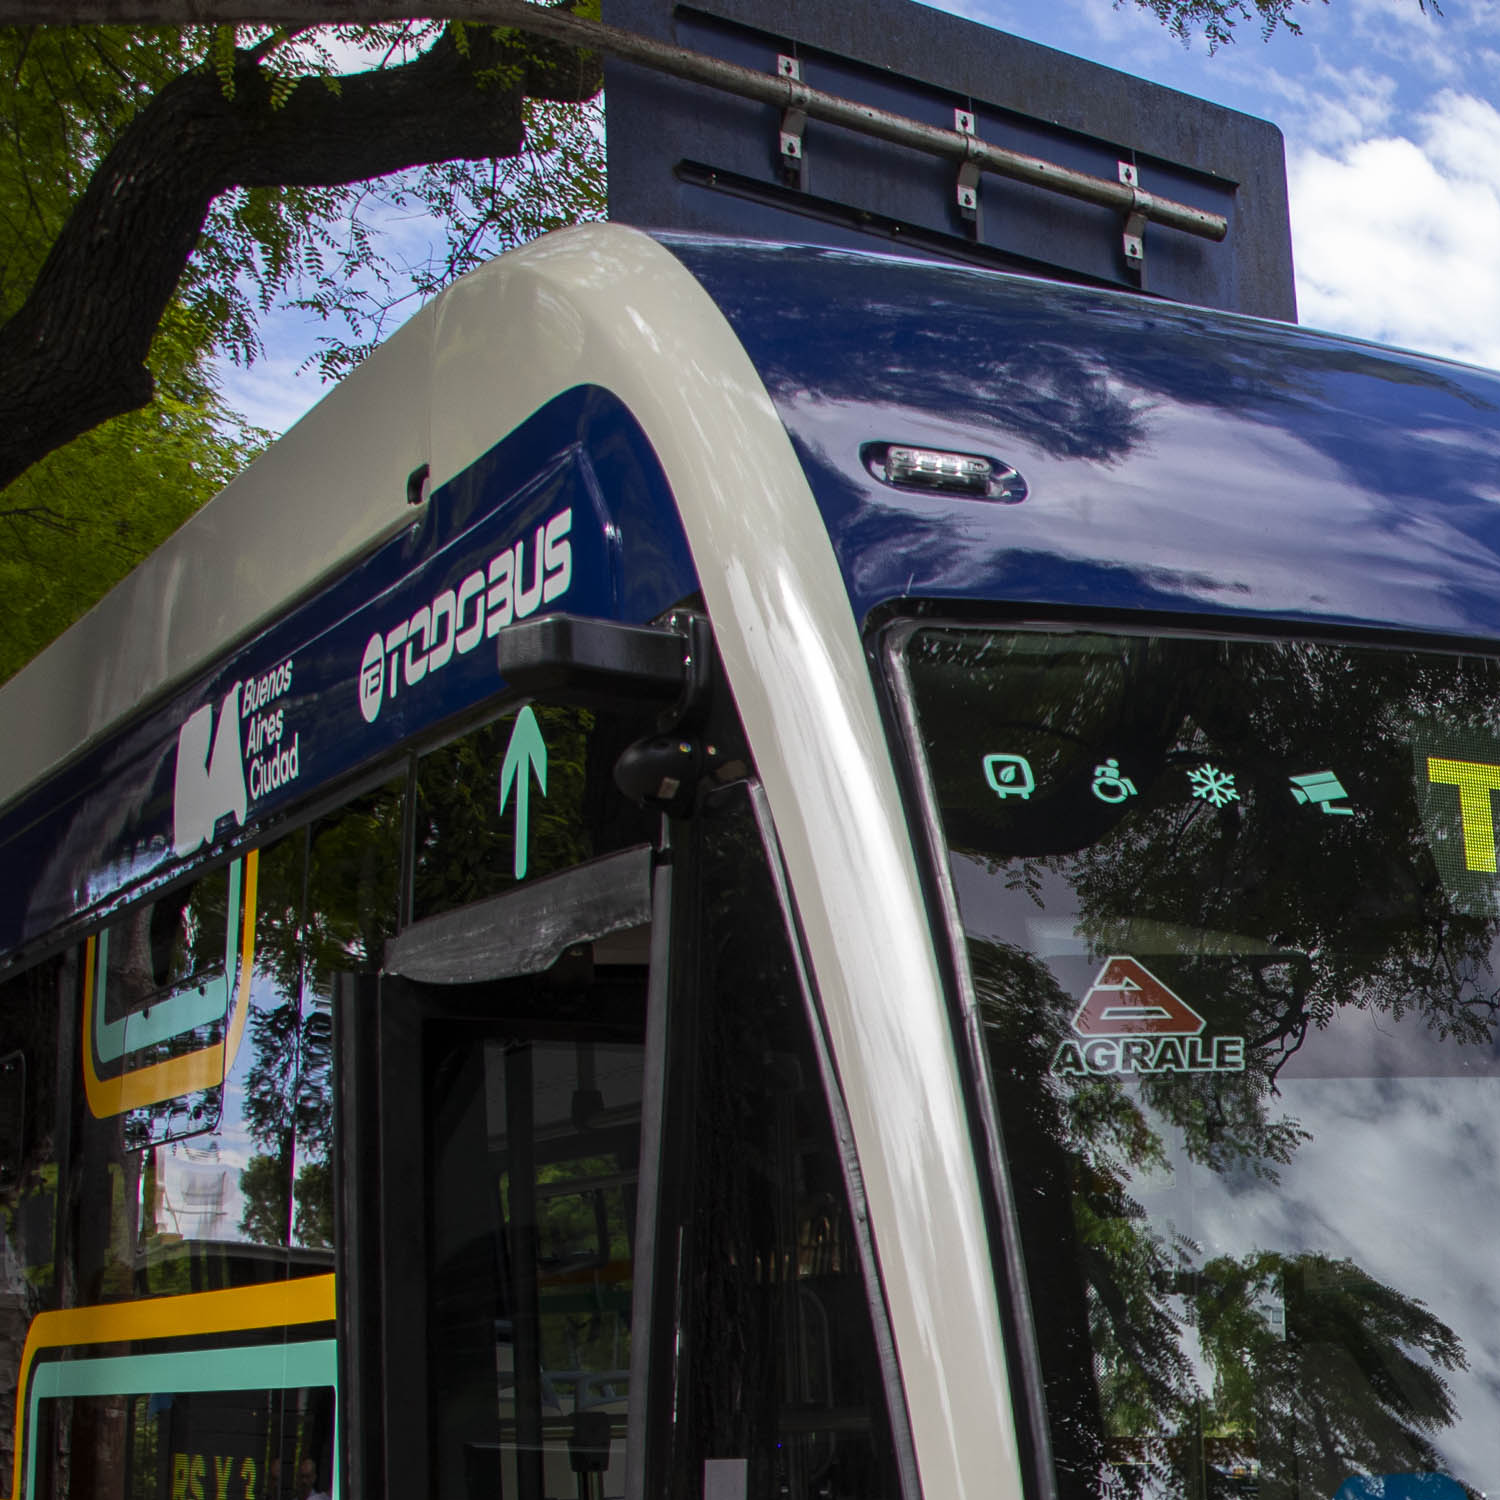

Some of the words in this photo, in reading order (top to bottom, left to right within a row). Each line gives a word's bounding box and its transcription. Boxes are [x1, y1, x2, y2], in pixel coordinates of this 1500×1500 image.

[385, 507, 572, 698] TODOBUS
[242, 660, 293, 719] Buenos
[246, 709, 284, 758] Aires
[250, 732, 299, 800] Ciudad
[1051, 1037, 1246, 1076] AGRALE
